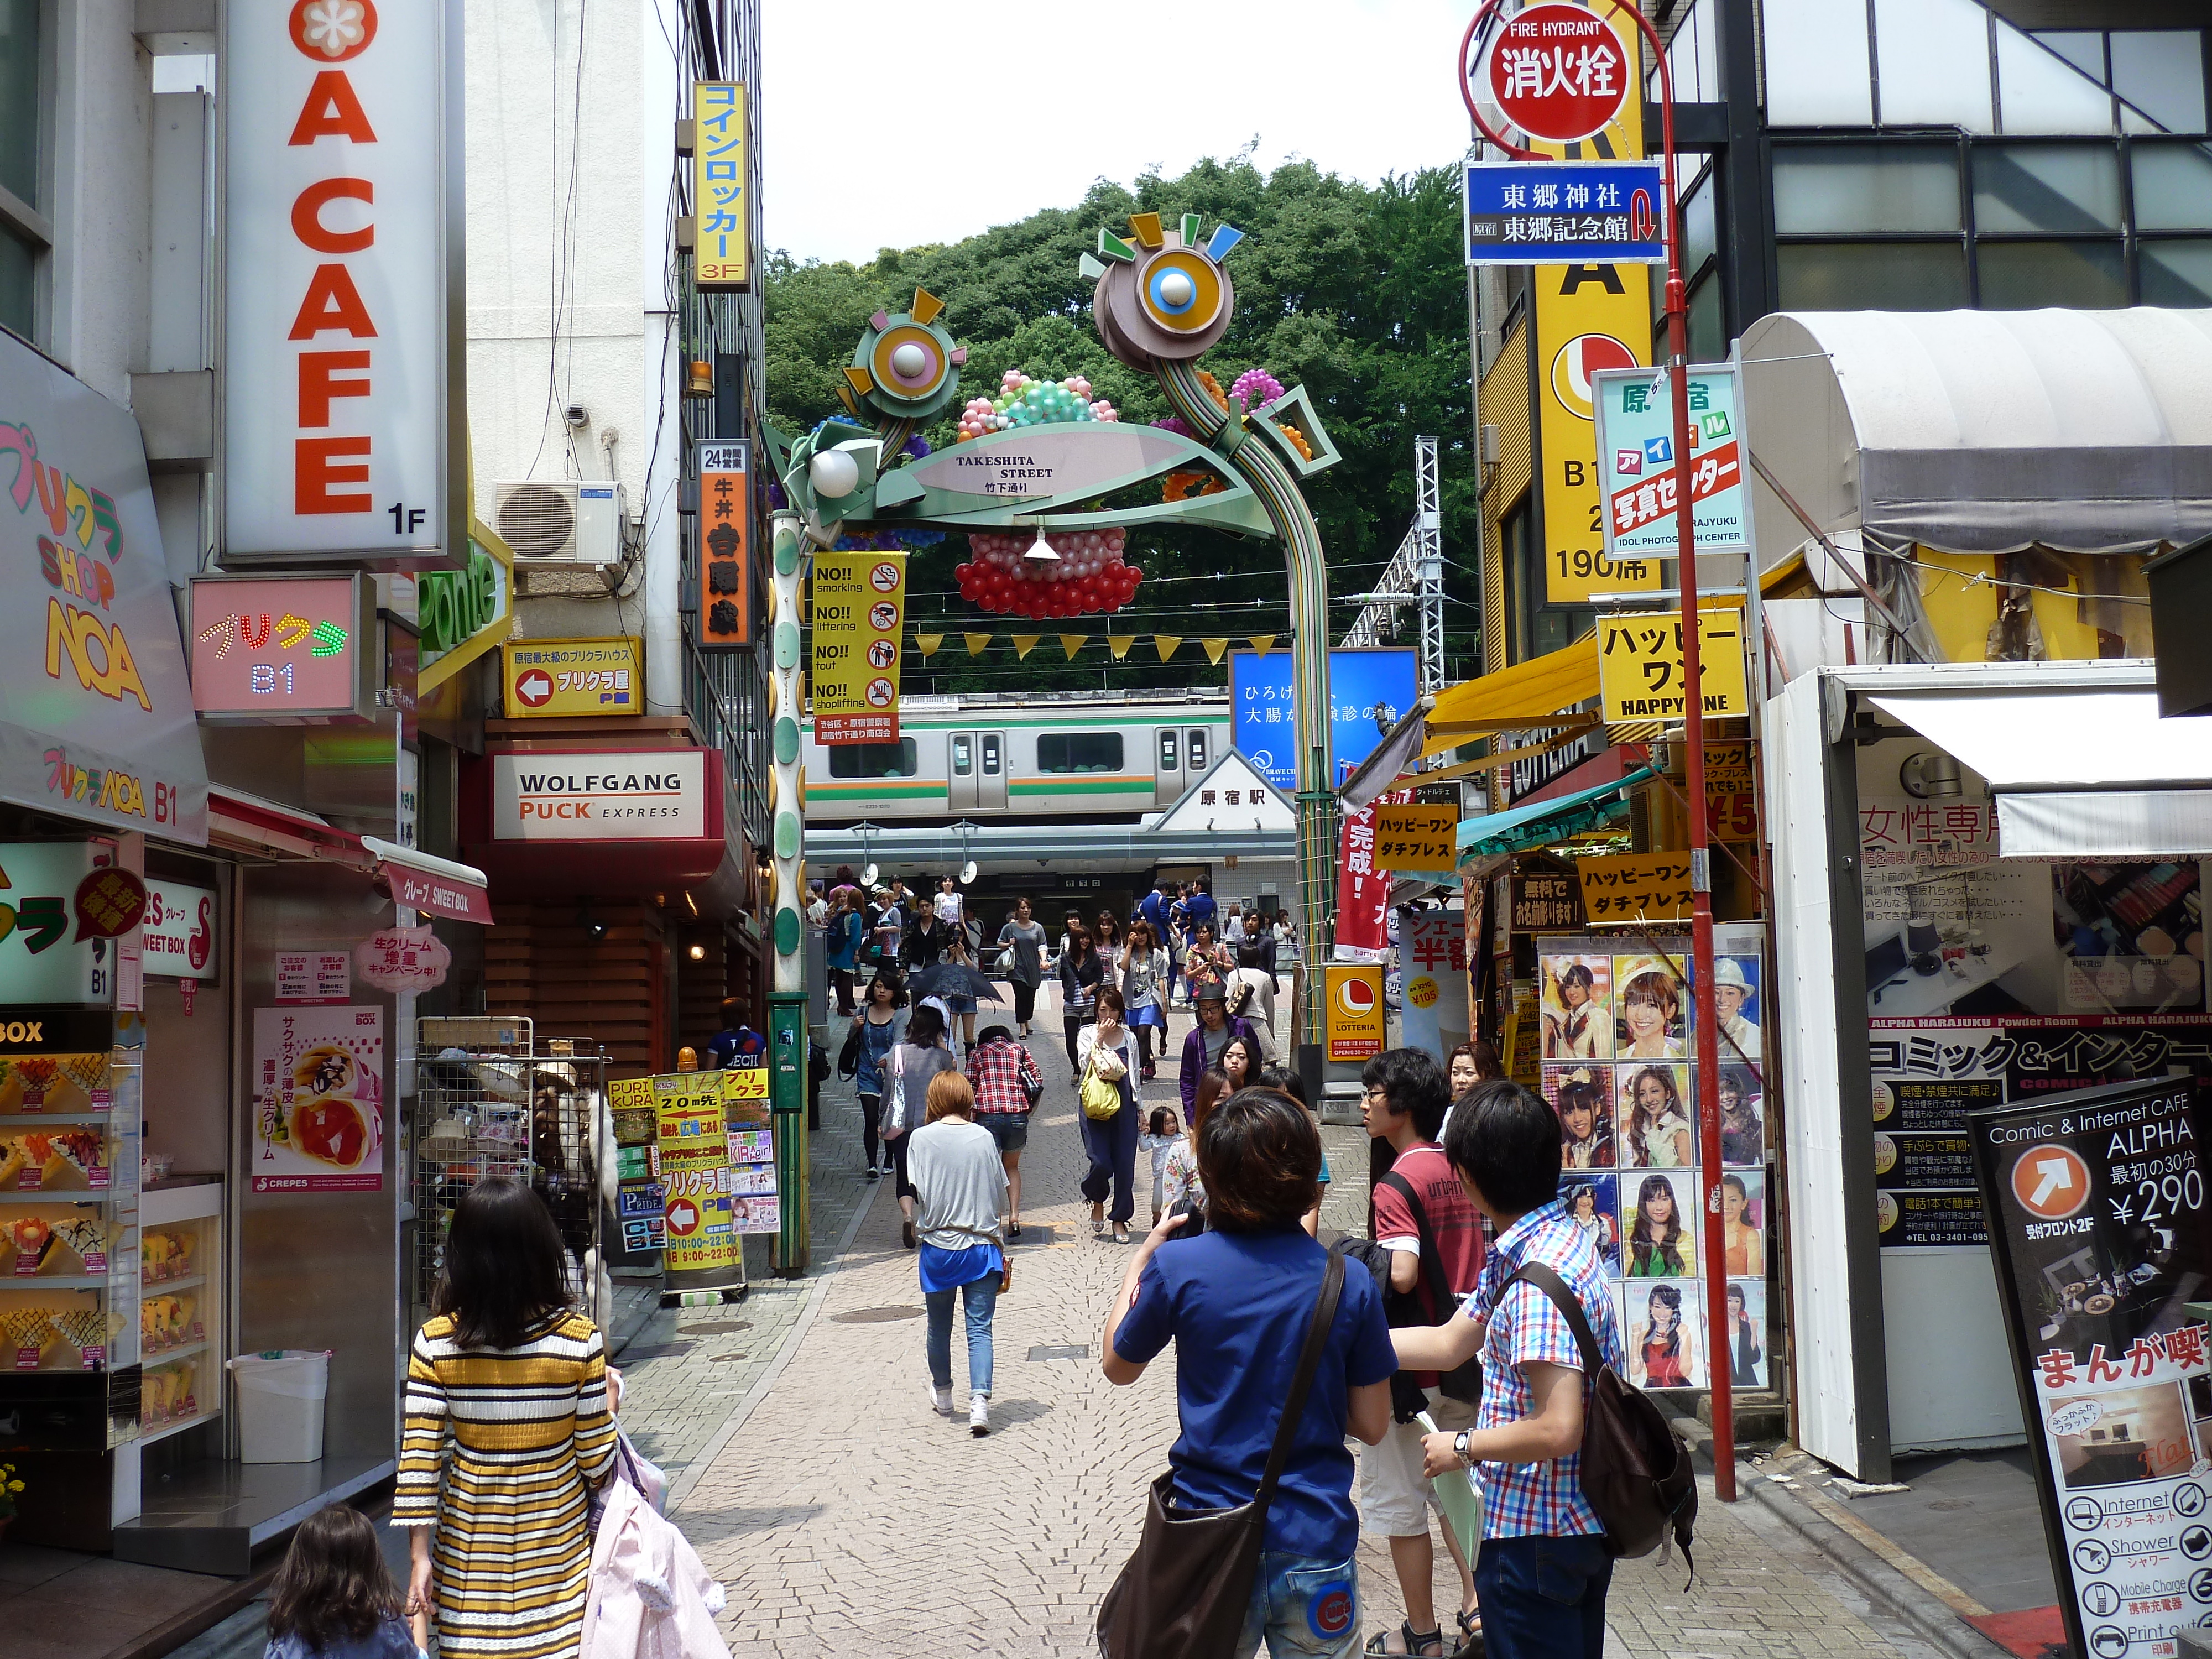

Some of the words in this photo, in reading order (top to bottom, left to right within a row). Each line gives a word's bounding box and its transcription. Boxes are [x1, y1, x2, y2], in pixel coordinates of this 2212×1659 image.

[1510, 22, 1538, 38] FIRE
[1542, 20, 1602, 37] HYDRANT
[1501, 45, 1617, 98] 消火栓
[702, 86, 742, 258] コインロッカー
[1501, 183, 1621, 209] 東郷神社
[1502, 216, 1628, 242] 東郷記念館
[701, 264, 742, 279] 3F
[705, 450, 721, 468] 24
[956, 456, 1035, 466] TAKESHITA
[1000, 468, 1053, 478] STREET
[985, 481, 1027, 493] 竹下通り
[388, 503, 426, 534] 1F
[1642, 535, 1703, 546] PHOTOGPH
[1704, 532, 1740, 542] CENTER
[37, 534, 115, 612] SHOP
[817, 568, 852, 581] NO!!
[817, 583, 863, 592] smorking
[817, 607, 851, 619] NO!!
[817, 622, 856, 631] littering
[199, 613, 348, 660] プリクラ
[46, 595, 152, 713] NOA
[514, 650, 629, 664] 原宿最大級のプリクラハウス
[816, 645, 849, 659] NO!!
[816, 661, 836, 670] tout
[252, 663, 294, 695] B1
[557, 670, 629, 692] プリクラ屋
[816, 684, 847, 697] NO!!
[817, 698, 865, 709] shoplifting
[1621, 697, 1684, 716] HAPPY
[1701, 695, 1728, 711] NE
[821, 729, 891, 740] 原宿竹下通り商店会
[519, 773, 681, 792] WOLFGANG
[155, 782, 176, 826] B1
[1201, 789, 1266, 805] 原宿駅
[519, 802, 591, 820] PUCK
[603, 807, 680, 818] EXPRESS
[1379, 818, 1454, 833] ハッピーワン
[1381, 841, 1450, 858] ダチブレス
[1585, 864, 1691, 887] ハッピーワン
[404, 878, 429, 903] クレープ
[432, 886, 455, 909] SWEET
[455, 893, 469, 912] BOX
[1525, 880, 1567, 898] 無料で
[1593, 889, 1694, 914] ダチブレス
[168, 938, 185, 954] BOX
[374, 937, 432, 952] 生クリーム
[385, 951, 417, 966] 増量
[92, 969, 106, 994] B1
[1412, 990, 1437, 1005] ¥105
[1871, 1019, 1915, 1029] ALPHA
[1918, 1018, 1990, 1028] HARAJUKU
[1997, 1018, 2042, 1027] Powder
[2045, 1018, 2078, 1026] Room
[2102, 1016, 2146, 1026] ALPHA
[611, 1083, 649, 1095] PURI
[735, 1084, 766, 1097] クラ
[2020, 1079, 2092, 1088] COMIC
[262, 1059, 276, 1160] 濃厚な生クリーム
[612, 1094, 654, 1107] KURA
[1990, 1121, 2053, 1144] Comic
[2060, 1118, 2075, 1134] &
[2080, 1104, 2147, 1131] Internet
[2151, 1093, 2188, 1117] CAFE
[2106, 1117, 2194, 1159] ALPHA
[2110, 1150, 2197, 1186] 最初の30分
[269, 1179, 307, 1187] CREPES
[2108, 1169, 2203, 1227] ¥290
[2025, 1215, 2094, 1241] 受付フロント2F
[2137, 1434, 2193, 1479] Flat
[2103, 1491, 2169, 1514] Internet
[2103, 1510, 2176, 1530] インターネット
[2111, 1535, 2174, 1554] Shower
[2127, 1556, 2170, 1569] シャワー
[2120, 1584, 2150, 1597] Mobile
[2152, 1578, 2187, 1595] Charge
[2128, 1597, 2183, 1615] 携帯充電器
[2128, 1624, 2164, 1641] Print
[2151, 1642, 2174, 1656] 印刷
